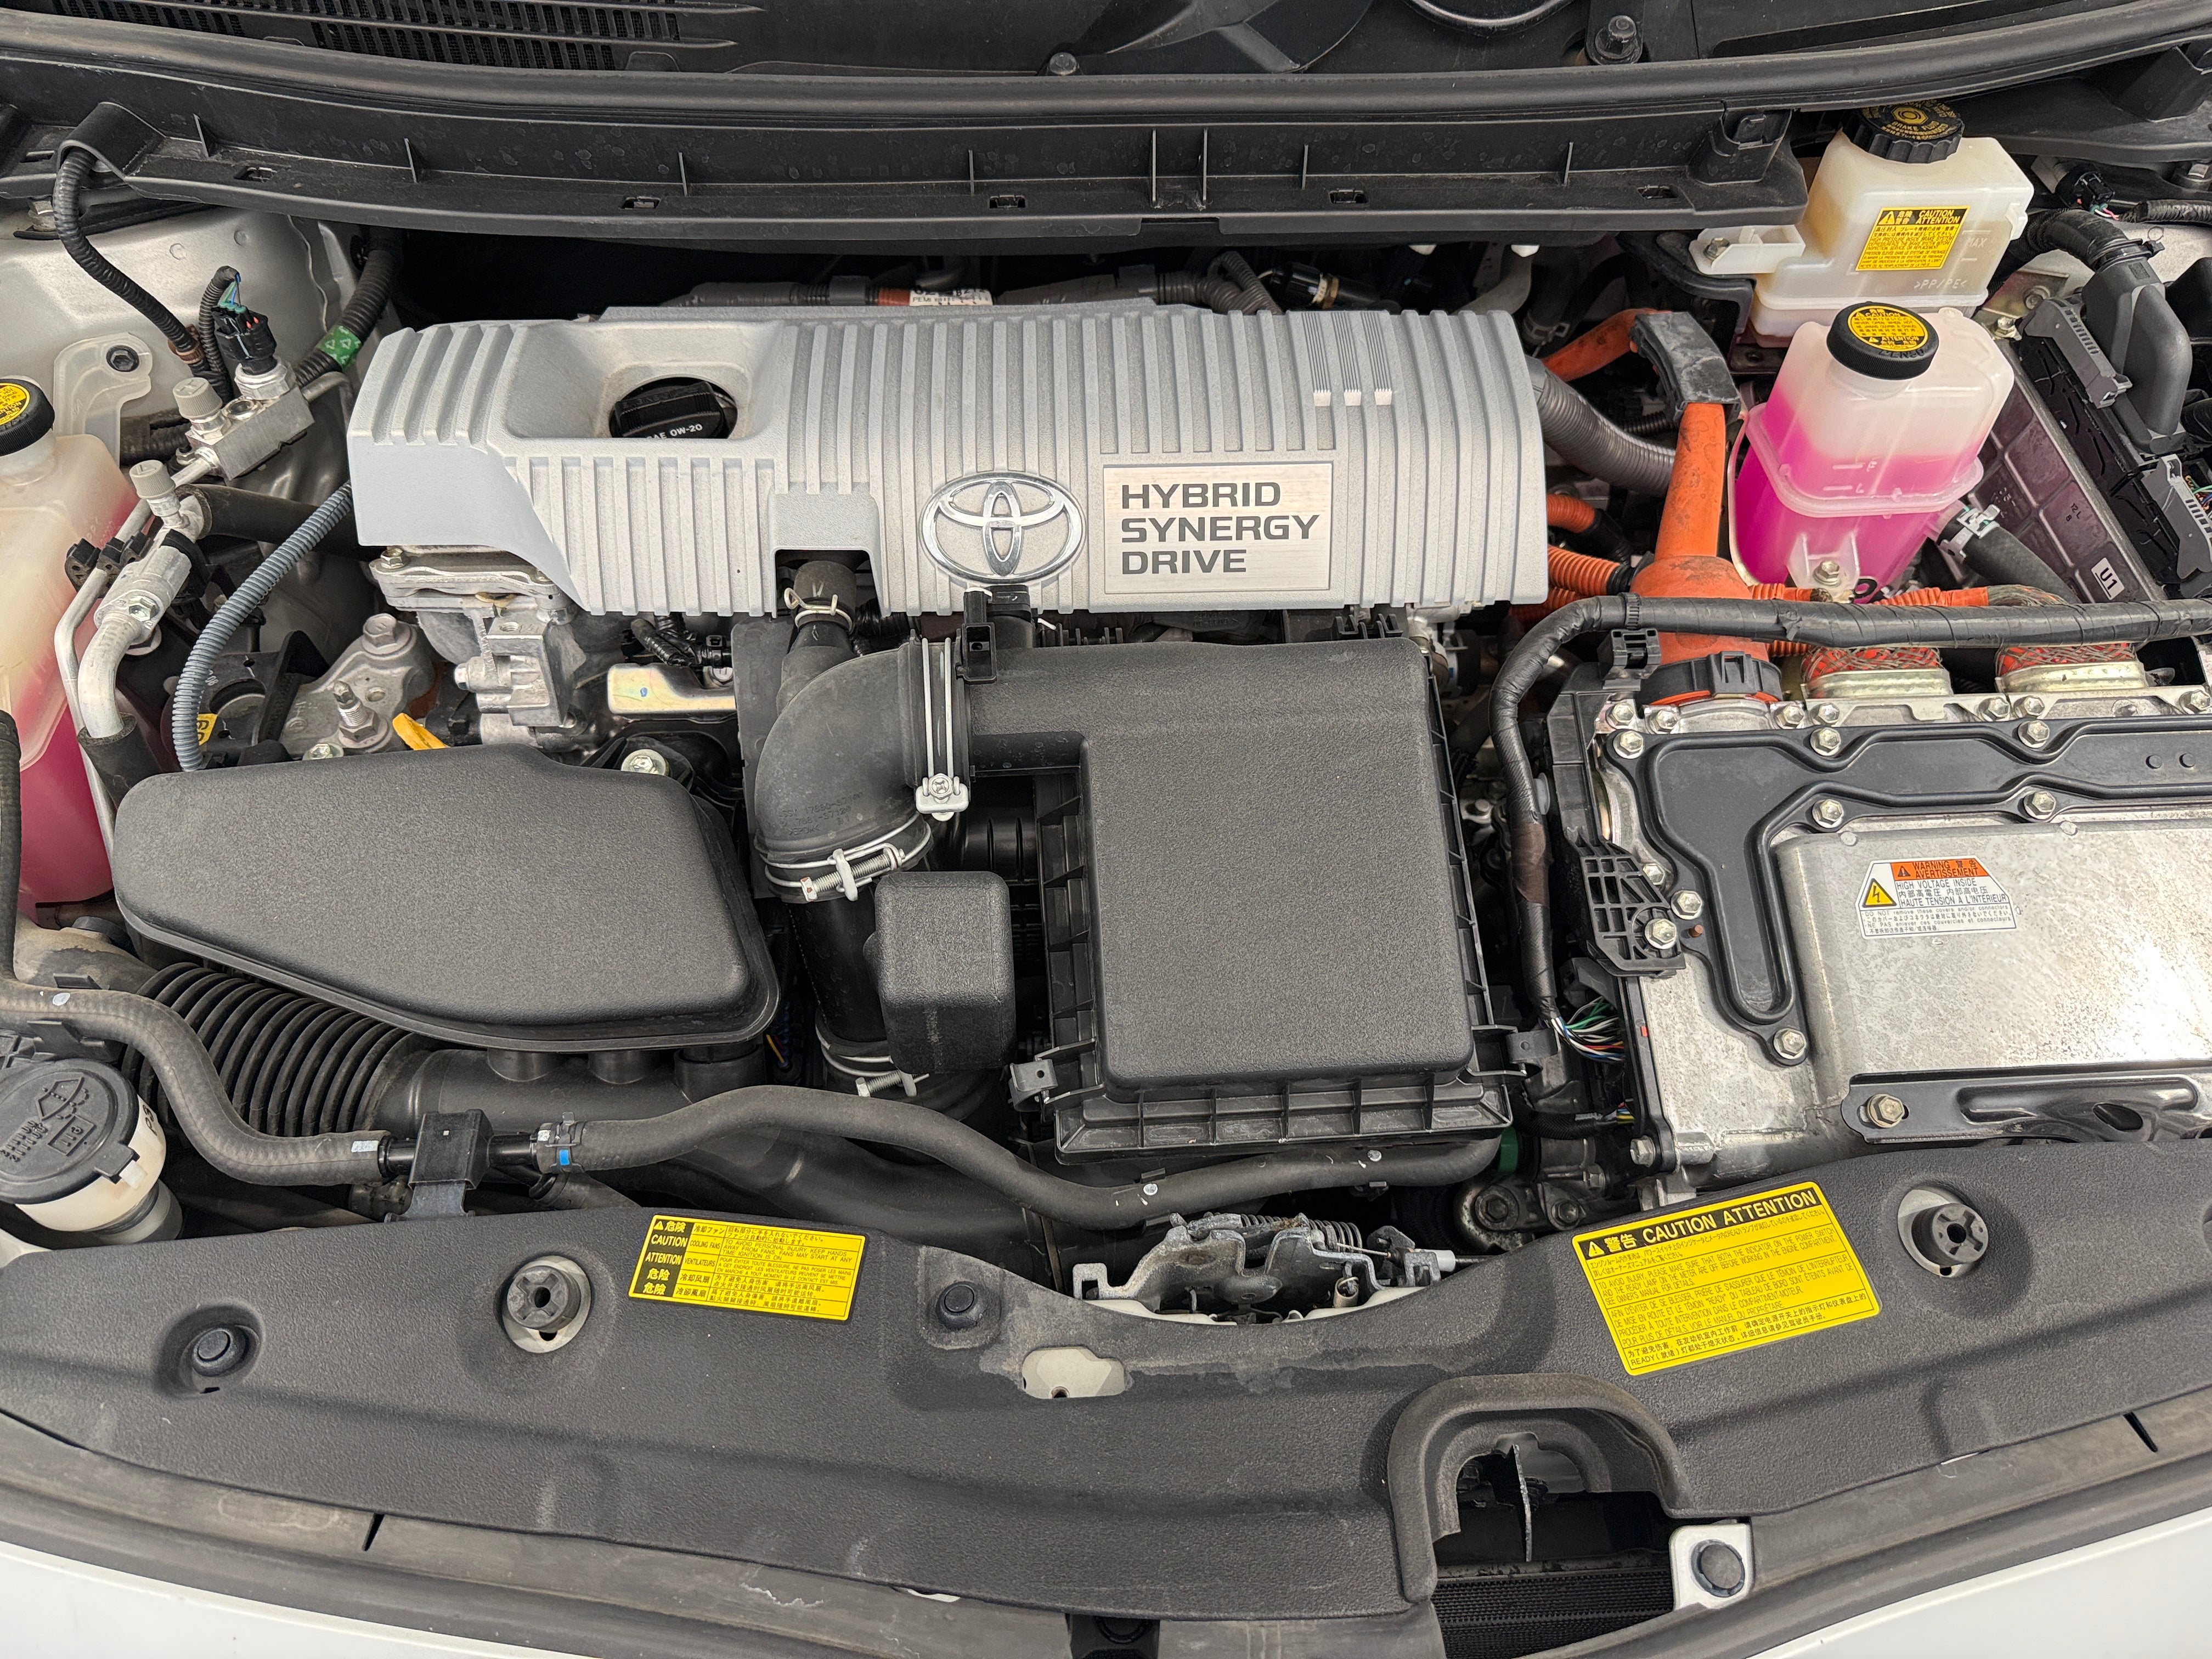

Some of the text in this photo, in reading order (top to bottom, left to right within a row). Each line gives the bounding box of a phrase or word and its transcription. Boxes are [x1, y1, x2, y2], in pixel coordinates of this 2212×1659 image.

[1916, 216, 1960, 224] ATTENTION
[1919, 210, 1954, 218] CAUTION
[669, 423, 703, 437] 0W-20
[1121, 482, 1281, 509] HYBRID
[1121, 514, 1320, 543] SYNERGY
[1121, 549, 1247, 575] DRIVE
[2099, 567, 2118, 590] U1
[1912, 860, 1950, 871] WARNING
[1915, 868, 1978, 879] AVERTISSEMENT
[1897, 878, 1977, 890] HIGH VOLTAGE INSIDE
[1900, 896, 1955, 907] HAUTE TENSION
[663, 1220, 687, 1233] 危険
[1604, 1190, 1818, 1253] 警告 CAUTION ATTENTION
[650, 1233, 689, 1248] CAUTION
[689, 1239, 709, 1248] COOLING
[644, 1251, 683, 1265] ATTENTION
[1607, 1277, 1625, 1287] AVOID
[1647, 1267, 1668, 1277] PLEASE
[1668, 1263, 1684, 1272] MAKE
[1685, 1259, 1700, 1268] SURE
[1701, 1255, 1716, 1265] THAT
[1716, 1251, 1732, 1261] BOTH
[1733, 1249, 1743, 1257] THE
[1783, 1237, 1793, 1245] THE
[1795, 1232, 1814, 1242] POWER
[1814, 1227, 1835, 1237] SWITCH
[646, 1267, 672, 1282] 危险
[1601, 1289, 1613, 1297] AND
[1613, 1286, 1625, 1294] THE
[1625, 1282, 1642, 1291] READY
[1643, 1278, 1658, 1287] LAMP
[1658, 1276, 1668, 1284] ON
[1668, 1273, 1679, 1281] THE
[1679, 1268, 1697, 1278] METER
[1696, 1266, 1708, 1274] ARE
[1708, 1263, 1719, 1271] OFF
[1719, 1259, 1739, 1268] BEFORE
[1740, 1252, 1763, 1264] WORKING
[1770, 1248, 1781, 1256] THE
[1781, 1244, 1799, 1254] ENGINE
[1605, 1297, 1616, 1305] SEE
[1639, 1286, 1661, 1297] MANUAL
[1661, 1283, 1673, 1292] FOR
[1610, 1308, 1624, 1318] AFIN
[1649, 1300, 1658, 1308] DE
[1658, 1298, 1667, 1306] SE
[1714, 1284, 1723, 1293] DE
[1753, 1274, 1766, 1283] QUE
[1766, 1272, 1775, 1280] LE
[1613, 1319, 1623, 1328] DE
[1637, 1313, 1646, 1322] EN
[1646, 1308, 1666, 1319] ROUTE
[1666, 1306, 1674, 1315] ET
[1674, 1305, 1683, 1313] LE
[1729, 1291, 1739, 1299] DU
[1739, 1285, 1763, 1297] TABLEAU
[1763, 1283, 1772, 1291] DE
[1772, 1279, 1788, 1289] BORD
[1788, 1275, 1804, 1284] SONT
[1825, 1265, 1844, 1276] AVANT
[1655, 1317, 1673, 1328] TOUTE
[1712, 1304, 1729, 1314] DANS
[1729, 1301, 1737, 1310] LE
[1622, 1336, 1638, 1346] POUR
[1639, 1333, 1654, 1342] PLUS
[1736, 1310, 1746, 1318] DU
